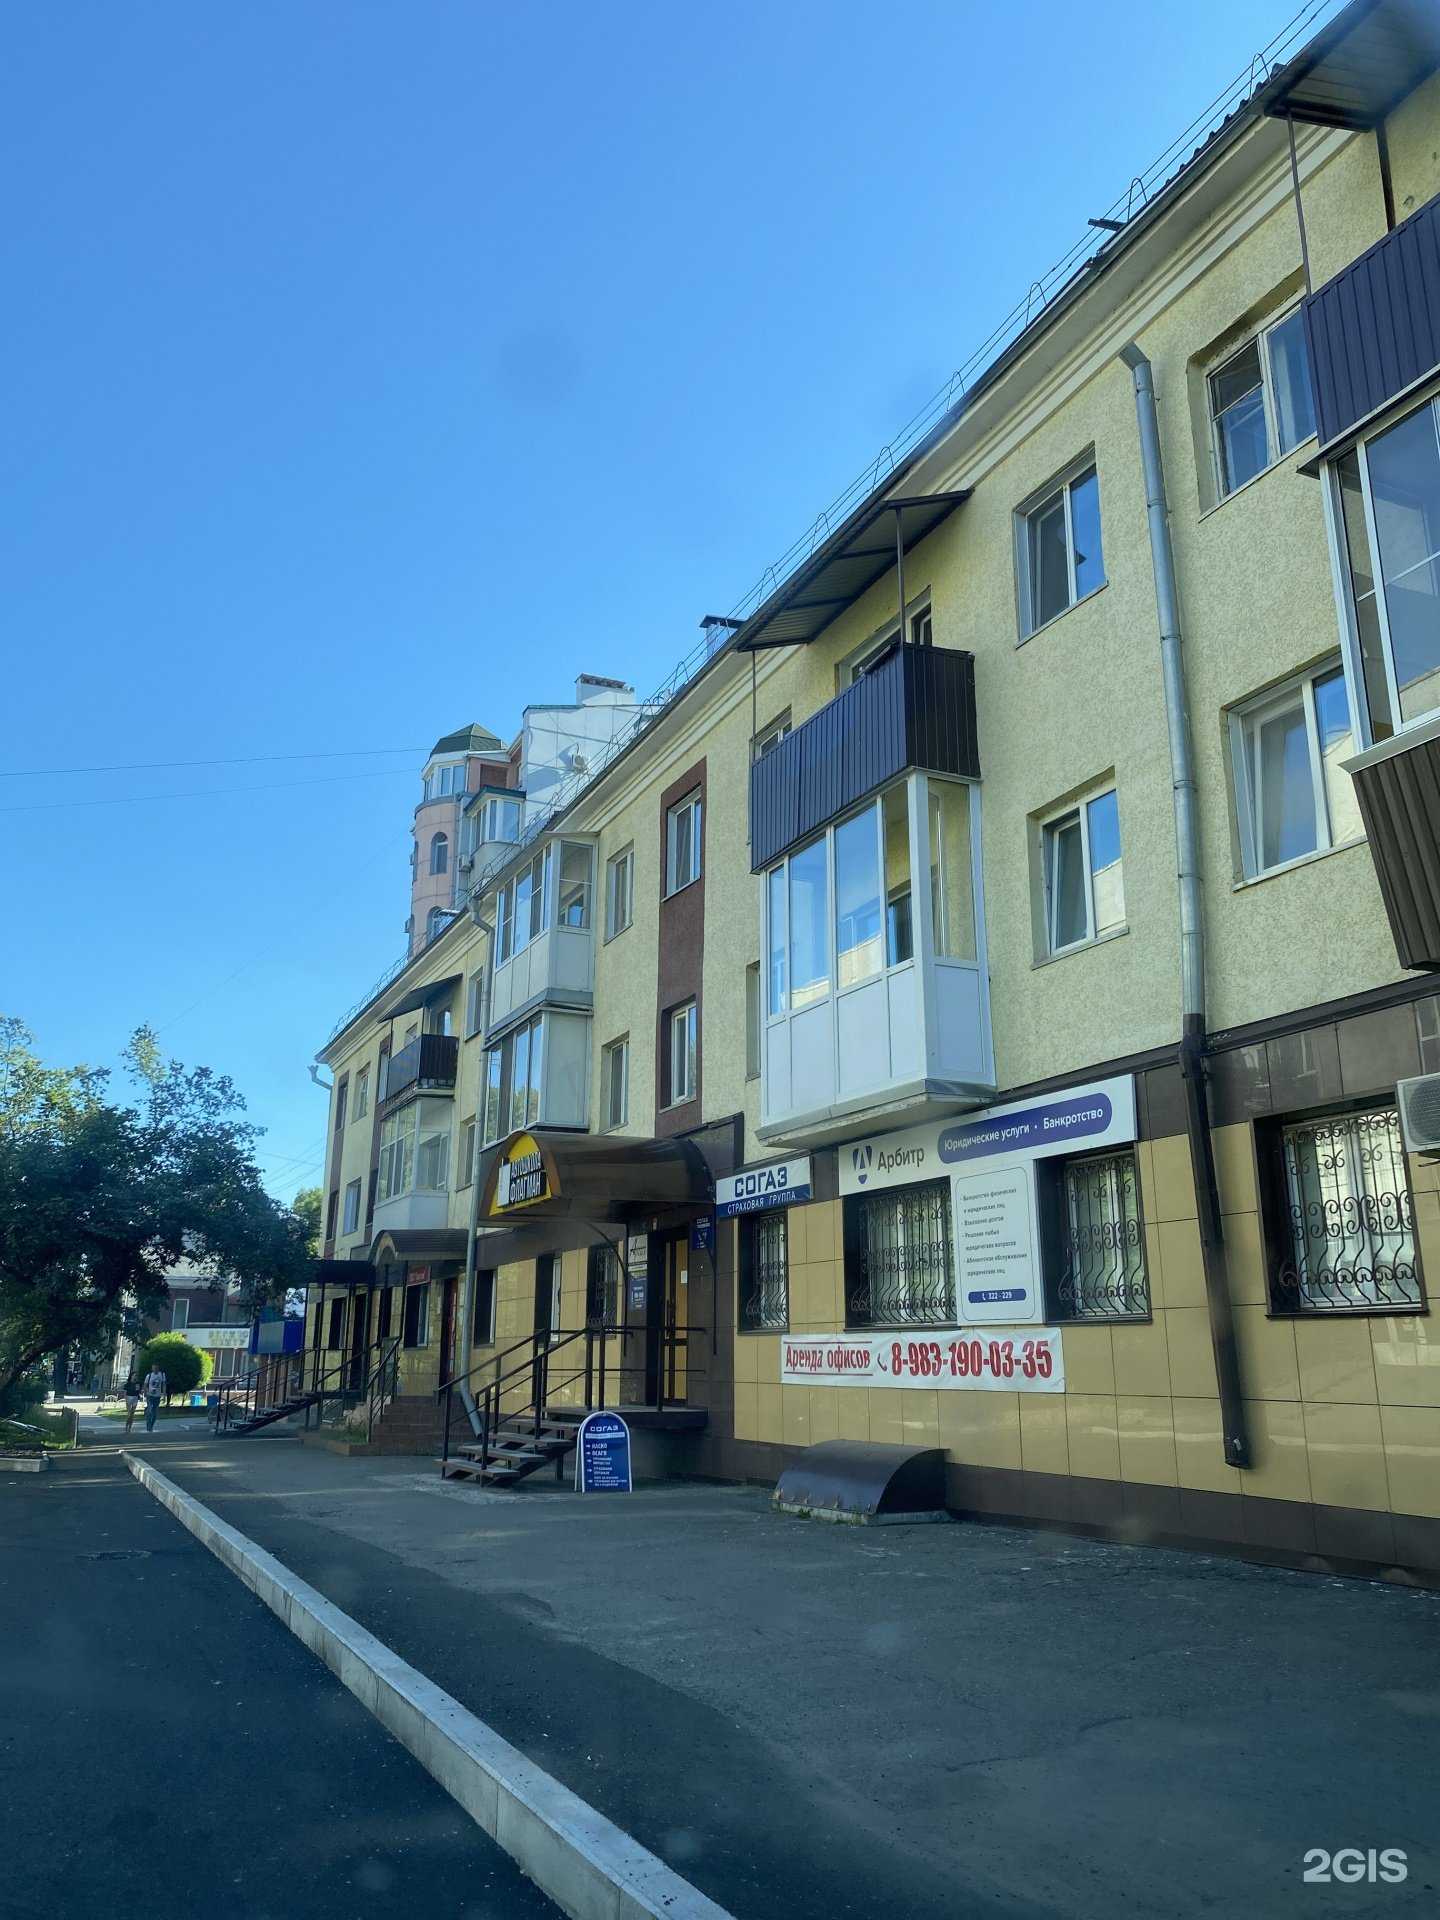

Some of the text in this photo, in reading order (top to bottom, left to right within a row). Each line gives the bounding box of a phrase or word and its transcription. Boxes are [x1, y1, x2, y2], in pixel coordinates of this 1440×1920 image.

[944, 1108, 1103, 1152] Юридические услуги Банкротство
[877, 1146, 925, 1171] Арбитр
[510, 1172, 541, 1203] ФЛАГМАН
[734, 1166, 787, 1198] СОГАЗ
[727, 1191, 796, 1215] СТРАХОВАЯ ГРУППА
[785, 1340, 1052, 1378] Аренда офисов 8-983-190-03-35
